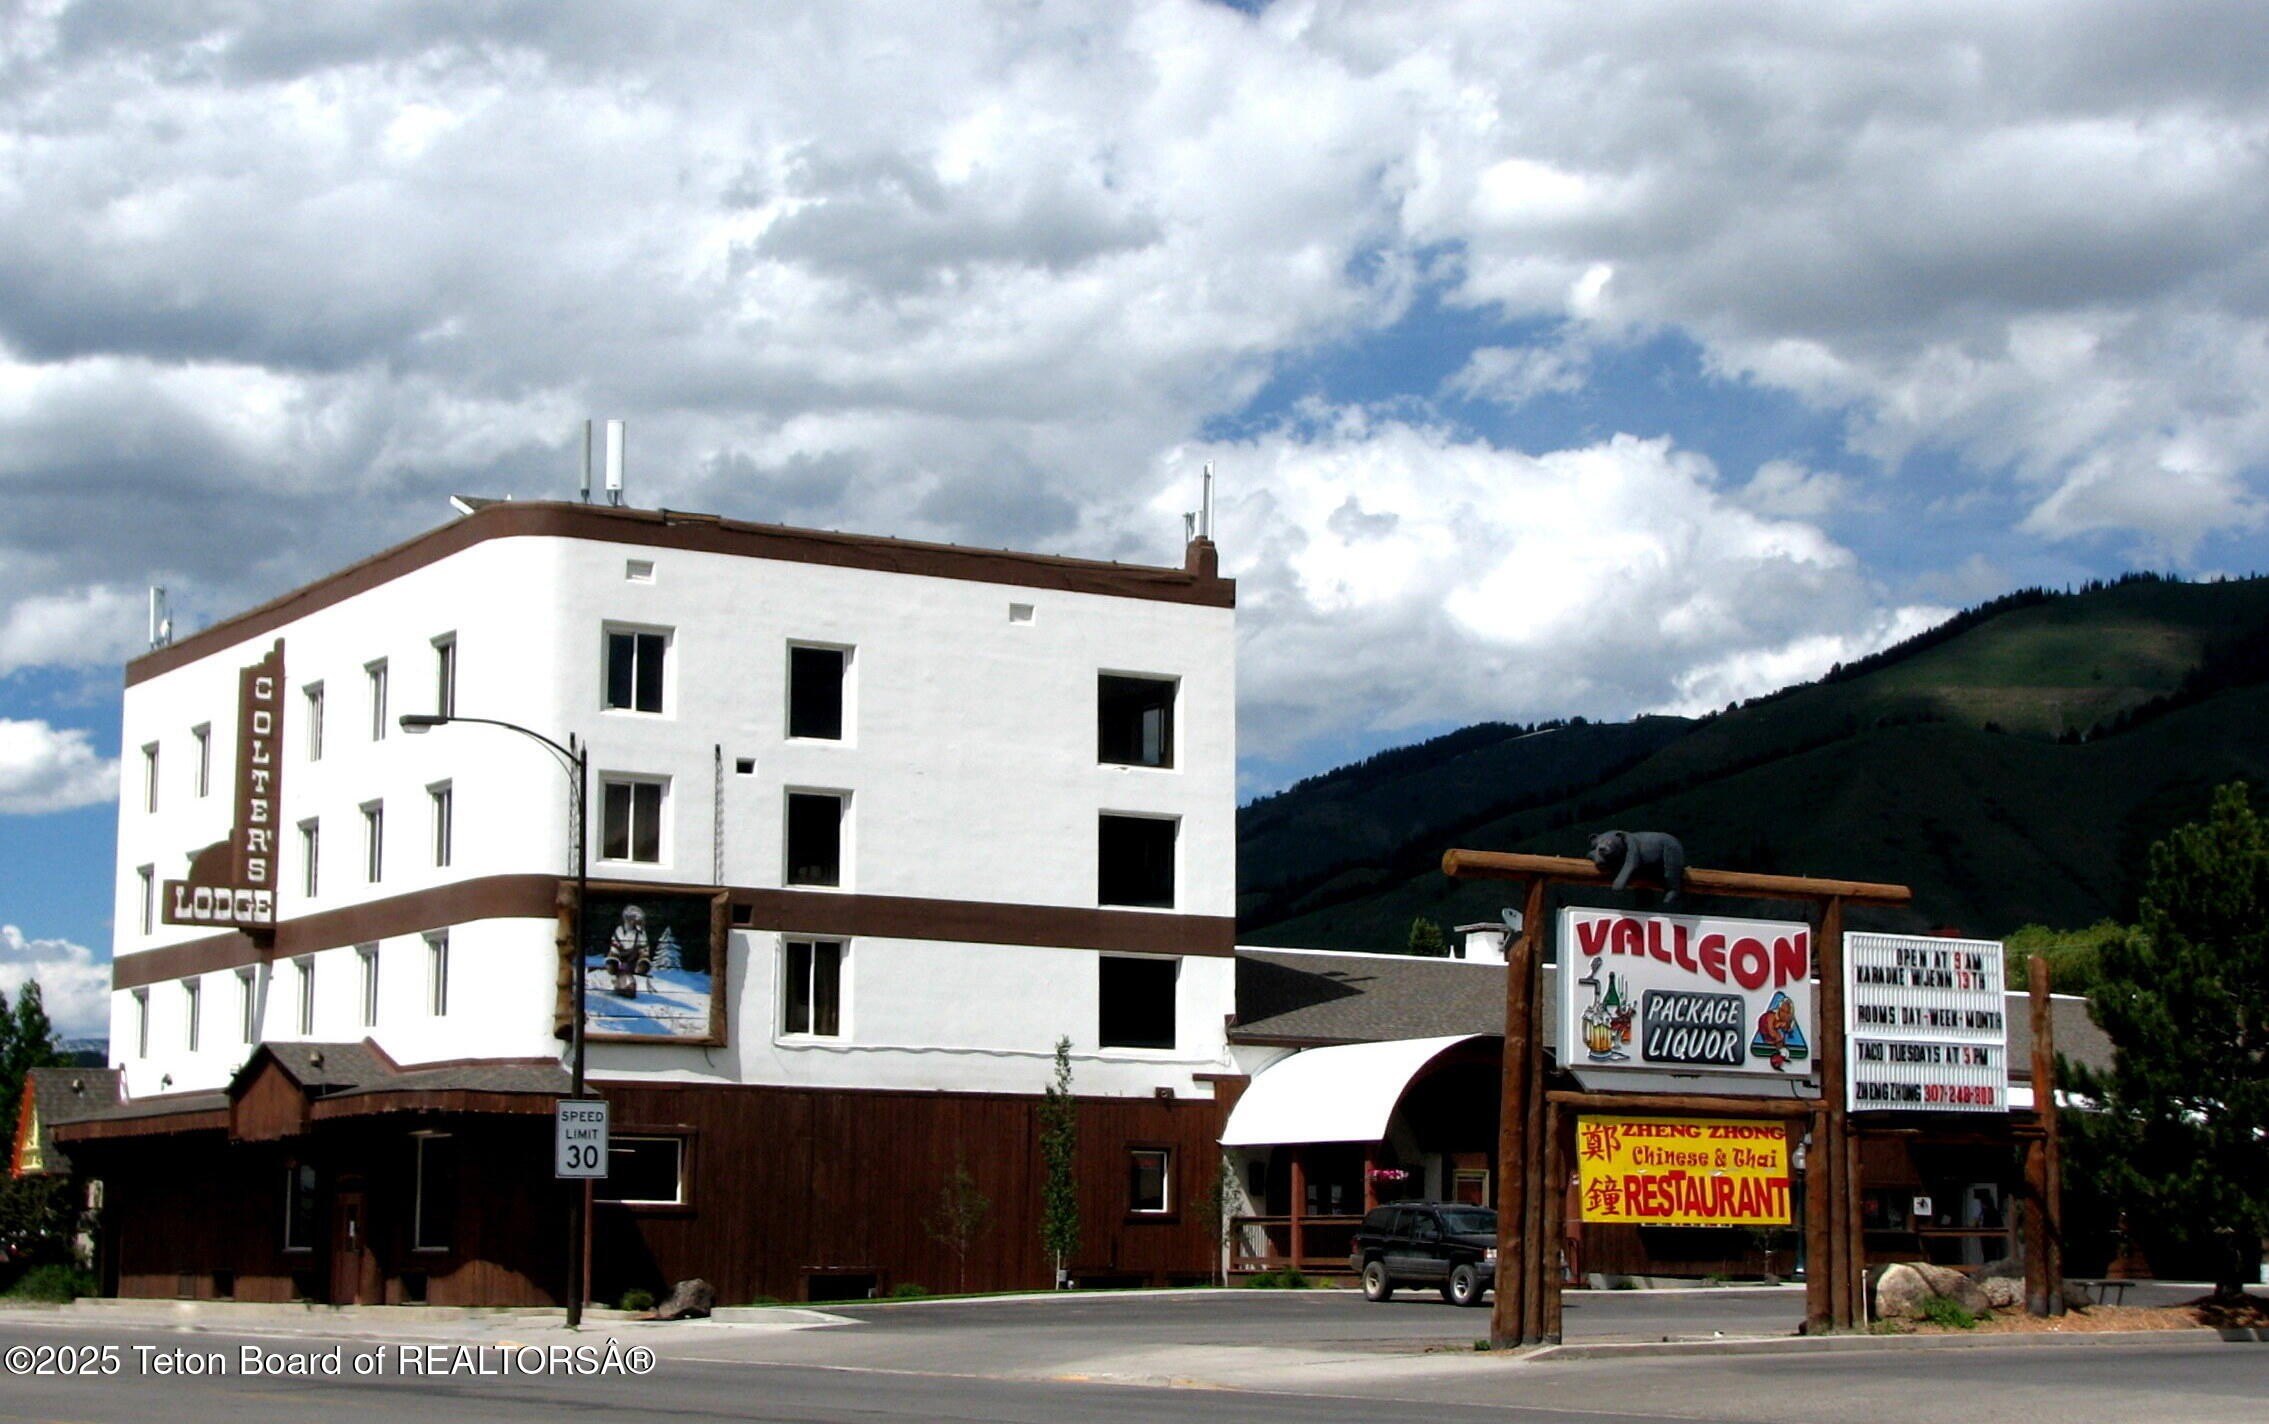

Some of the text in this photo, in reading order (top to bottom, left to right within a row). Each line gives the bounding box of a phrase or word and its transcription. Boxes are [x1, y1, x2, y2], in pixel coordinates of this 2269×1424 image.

[247, 676, 273, 882] COLTER'S
[174, 886, 272, 922] LODGE
[1576, 918, 1807, 990] VALLEON
[1897, 949, 1981, 970] OPEN AT 9 AM
[1857, 966, 1904, 985] KARAOKE
[1649, 996, 1739, 1023] PACKAGE
[1858, 1005, 1895, 1024] ROOMS
[1649, 1028, 1739, 1062] LIQUOR
[1858, 1043, 1883, 1060] TACO
[1889, 1044, 1940, 1062] TUESDAYS
[1946, 1047, 1959, 1063] AT
[561, 1111, 604, 1122] SPEED
[566, 1128, 598, 1140] LIMIT
[1621, 1123, 1786, 1140] ZHENG ZHONG
[567, 1145, 598, 1168] 30
[1632, 1145, 1778, 1168] Chinese & Thai
[1623, 1170, 1790, 1218] RESTAURANT
